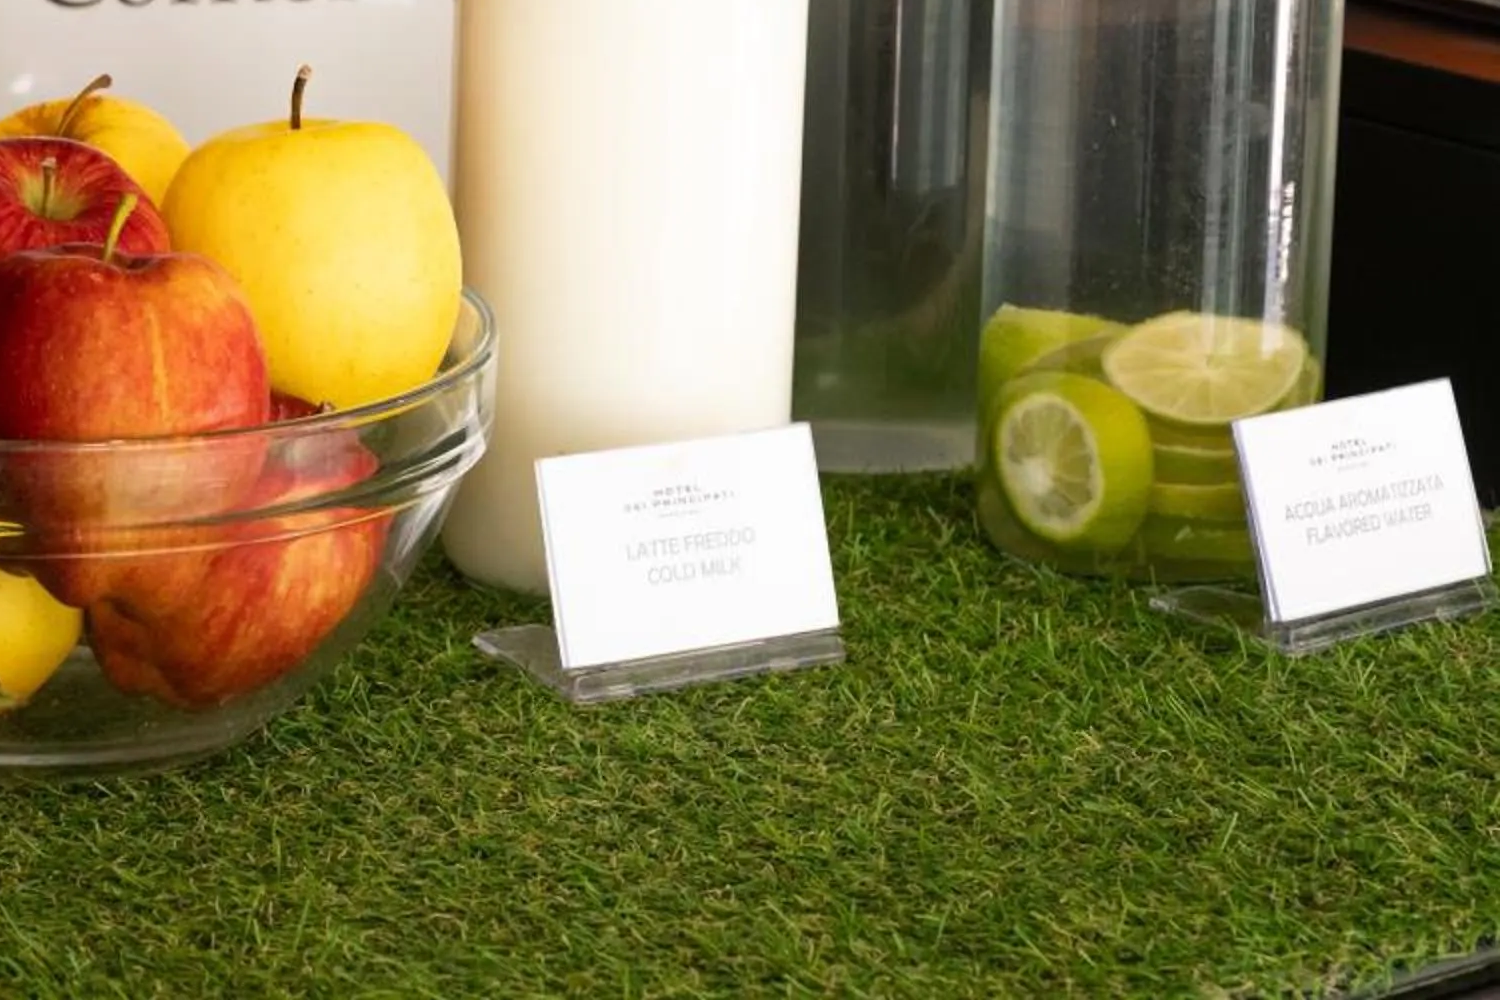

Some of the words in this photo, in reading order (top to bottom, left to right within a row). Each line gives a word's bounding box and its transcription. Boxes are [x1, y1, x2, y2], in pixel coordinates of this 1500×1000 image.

[1285, 497, 1336, 521] ACQUA
[1306, 514, 1381, 546] FLAVORED
[1383, 503, 1432, 527] WATER
[625, 537, 681, 562] LATTE
[683, 527, 757, 553] FREDDO
[647, 562, 697, 586] COLD
[701, 554, 742, 578] MILK
